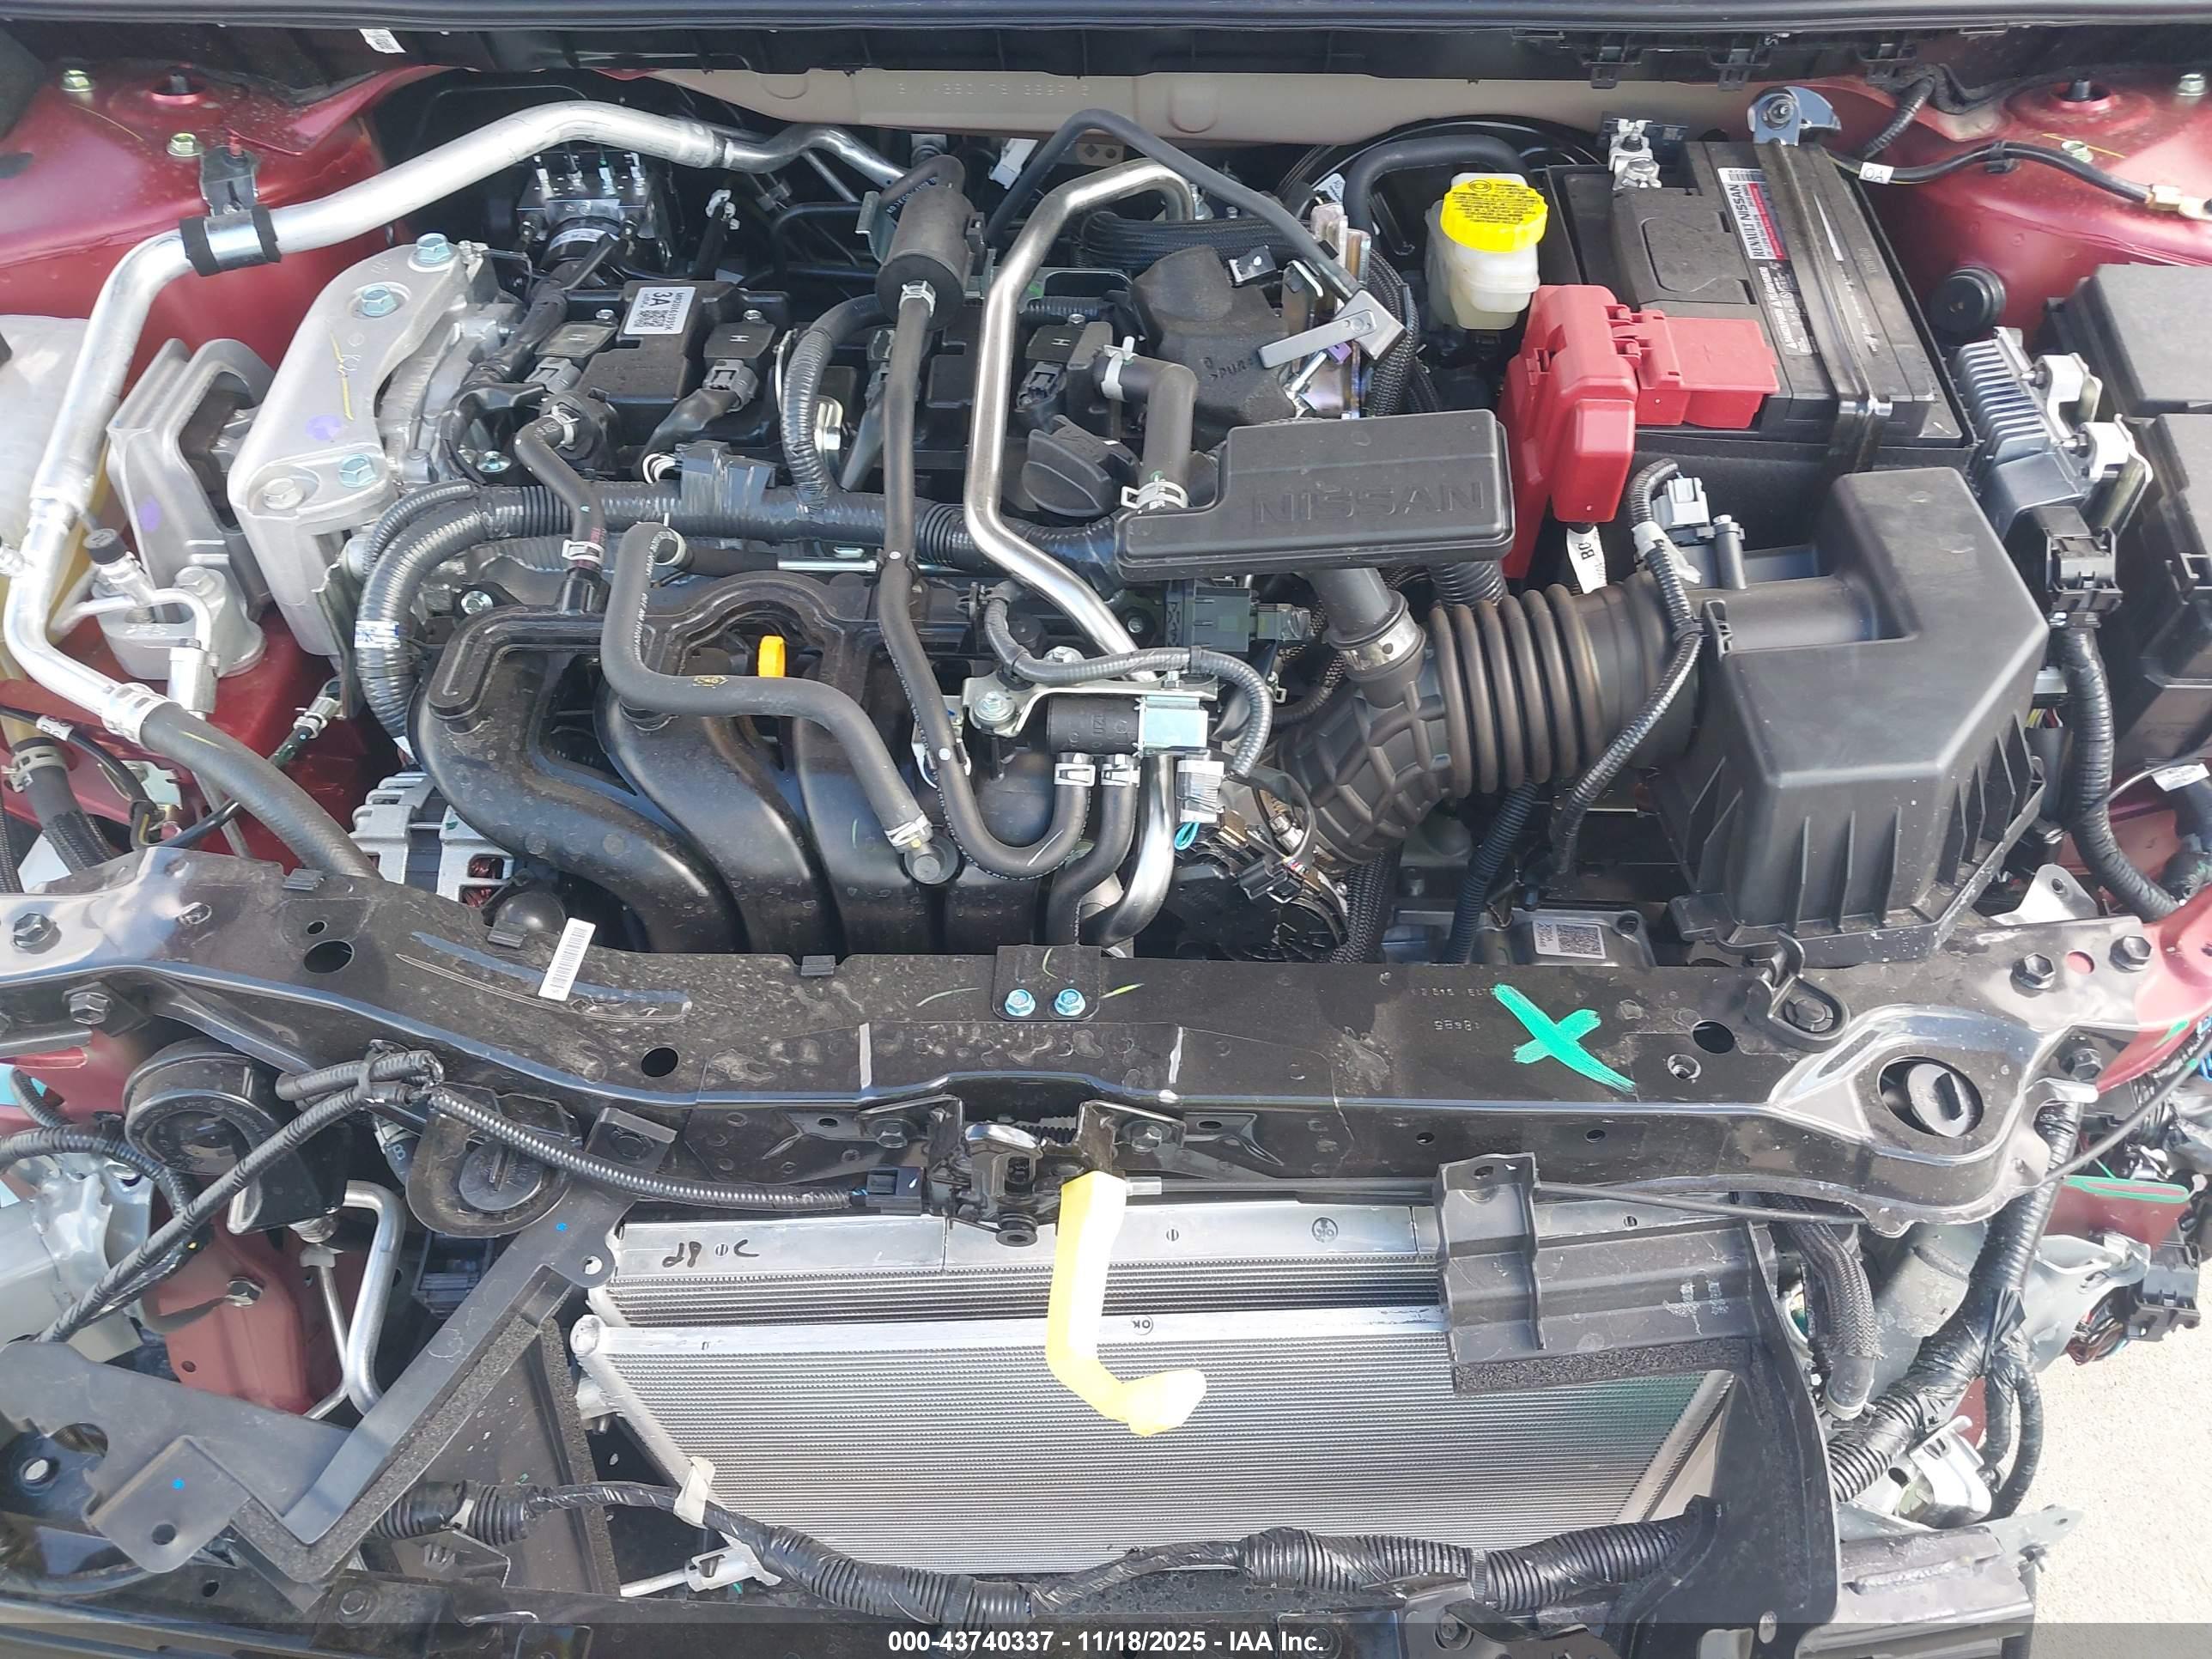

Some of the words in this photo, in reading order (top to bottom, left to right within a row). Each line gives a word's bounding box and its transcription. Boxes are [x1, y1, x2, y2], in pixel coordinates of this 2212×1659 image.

[1728, 184, 1752, 221] NISSAN
[1742, 222, 1766, 257] RENAULT
[650, 292, 672, 307] 3A
[1252, 481, 1486, 523] NISSAN
[1132, 1320, 1151, 1328] OK
